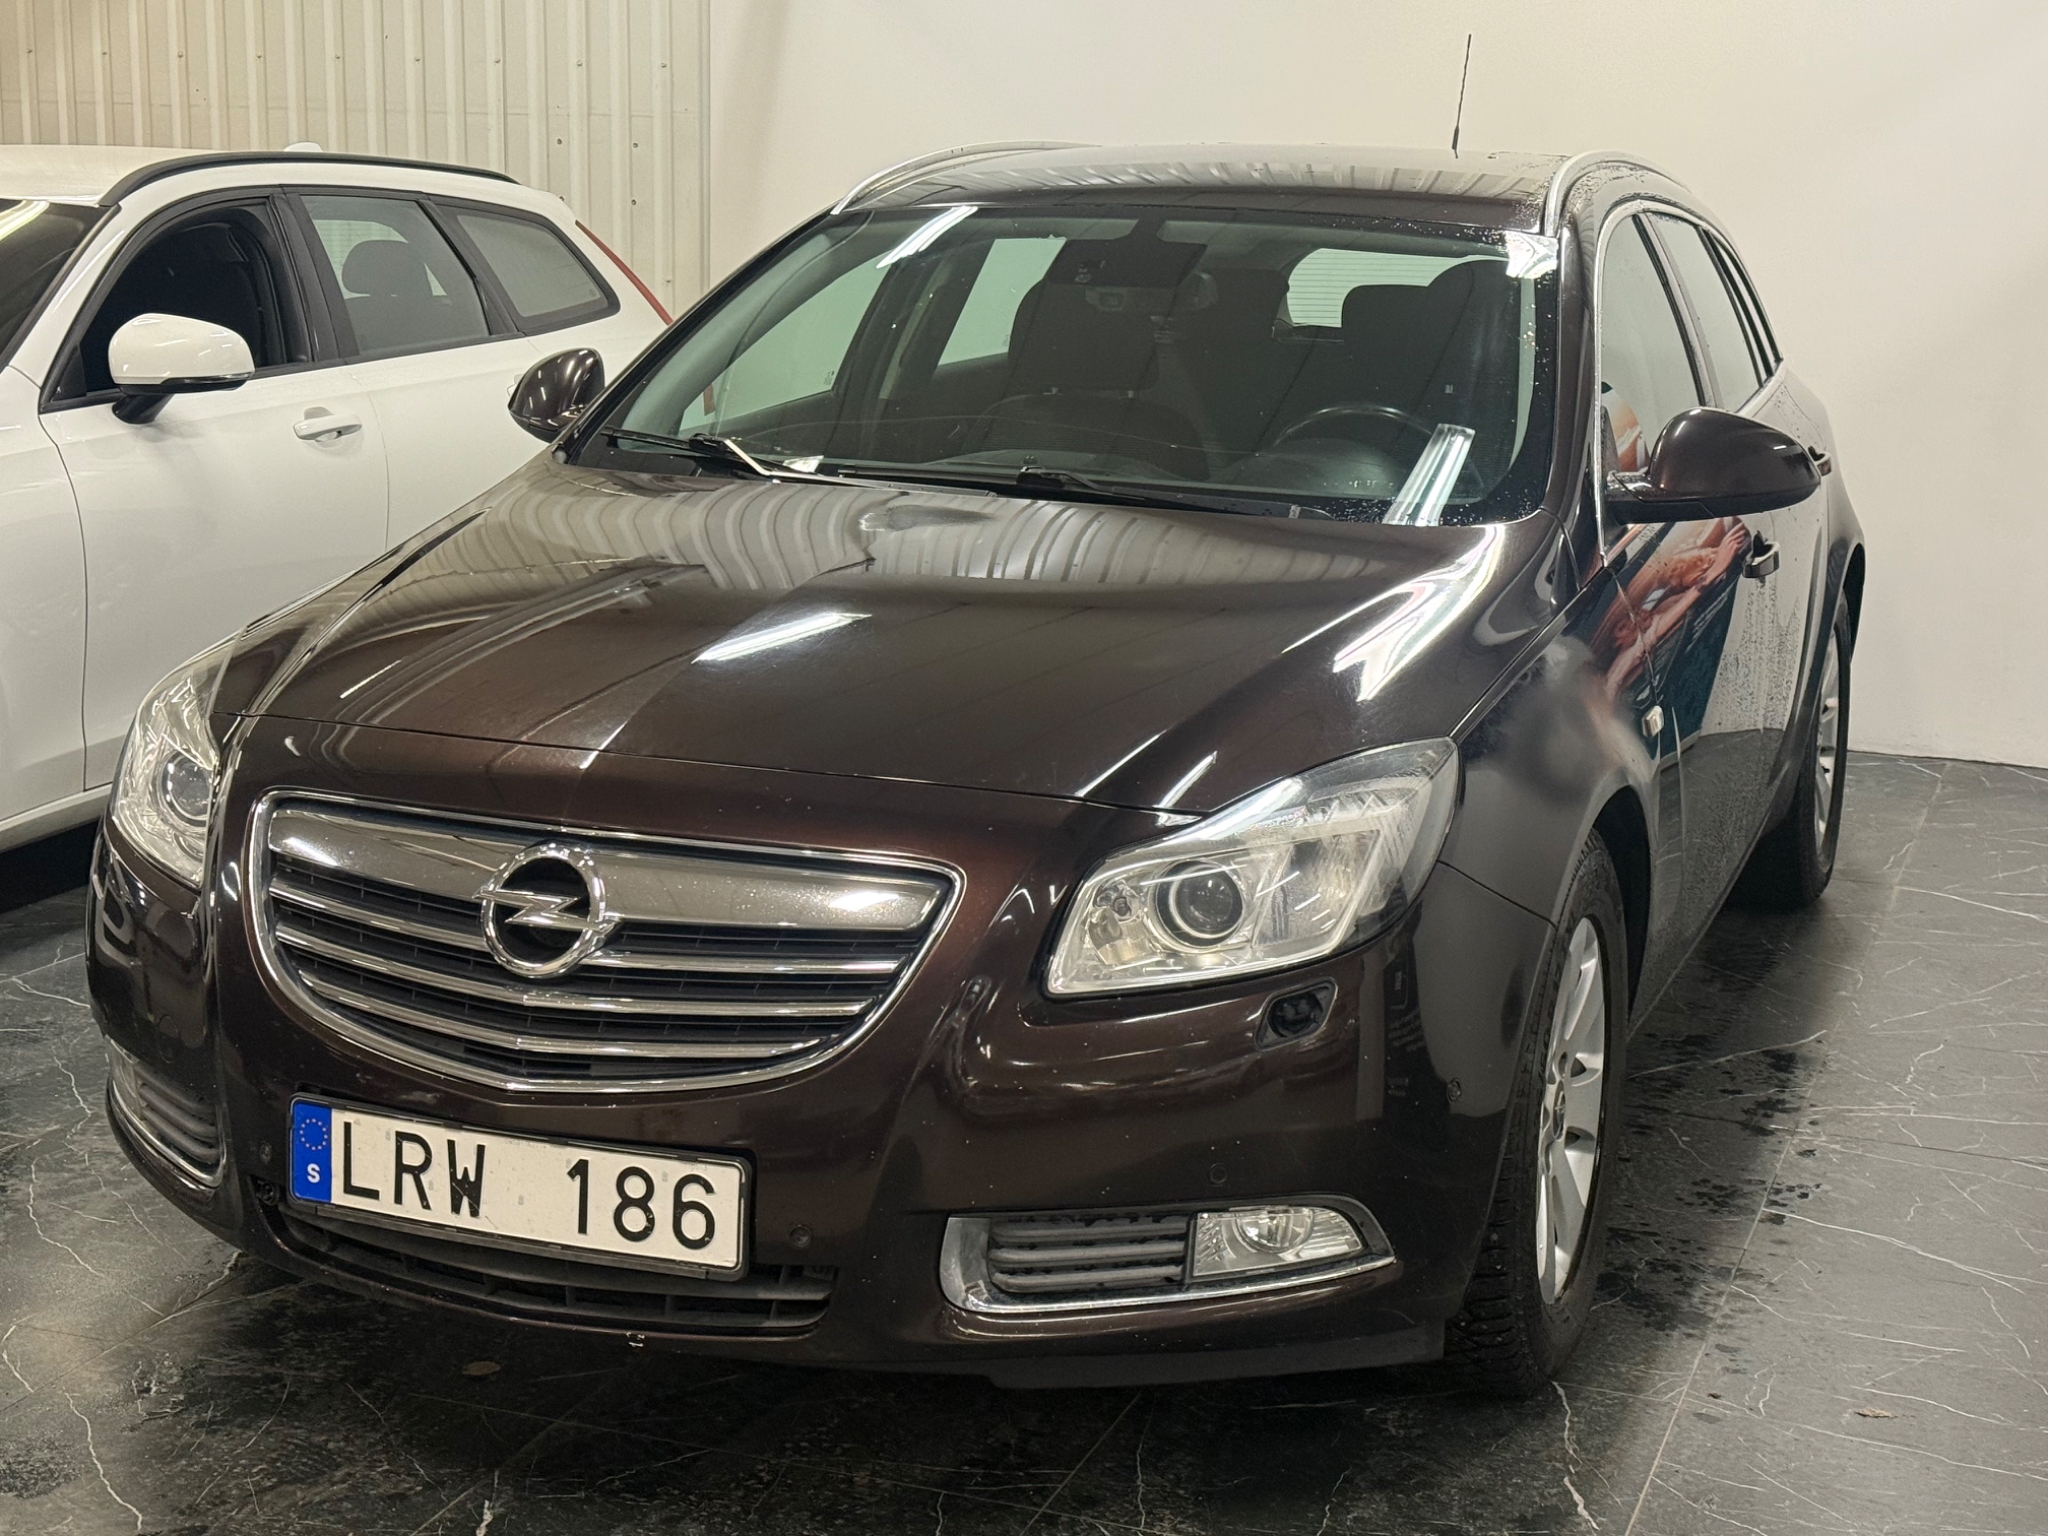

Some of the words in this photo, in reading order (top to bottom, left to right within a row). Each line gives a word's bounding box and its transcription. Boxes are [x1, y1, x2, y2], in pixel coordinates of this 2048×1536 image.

[307, 1163, 320, 1183] S
[343, 1121, 485, 1217] LRW
[567, 1158, 715, 1249] 186
